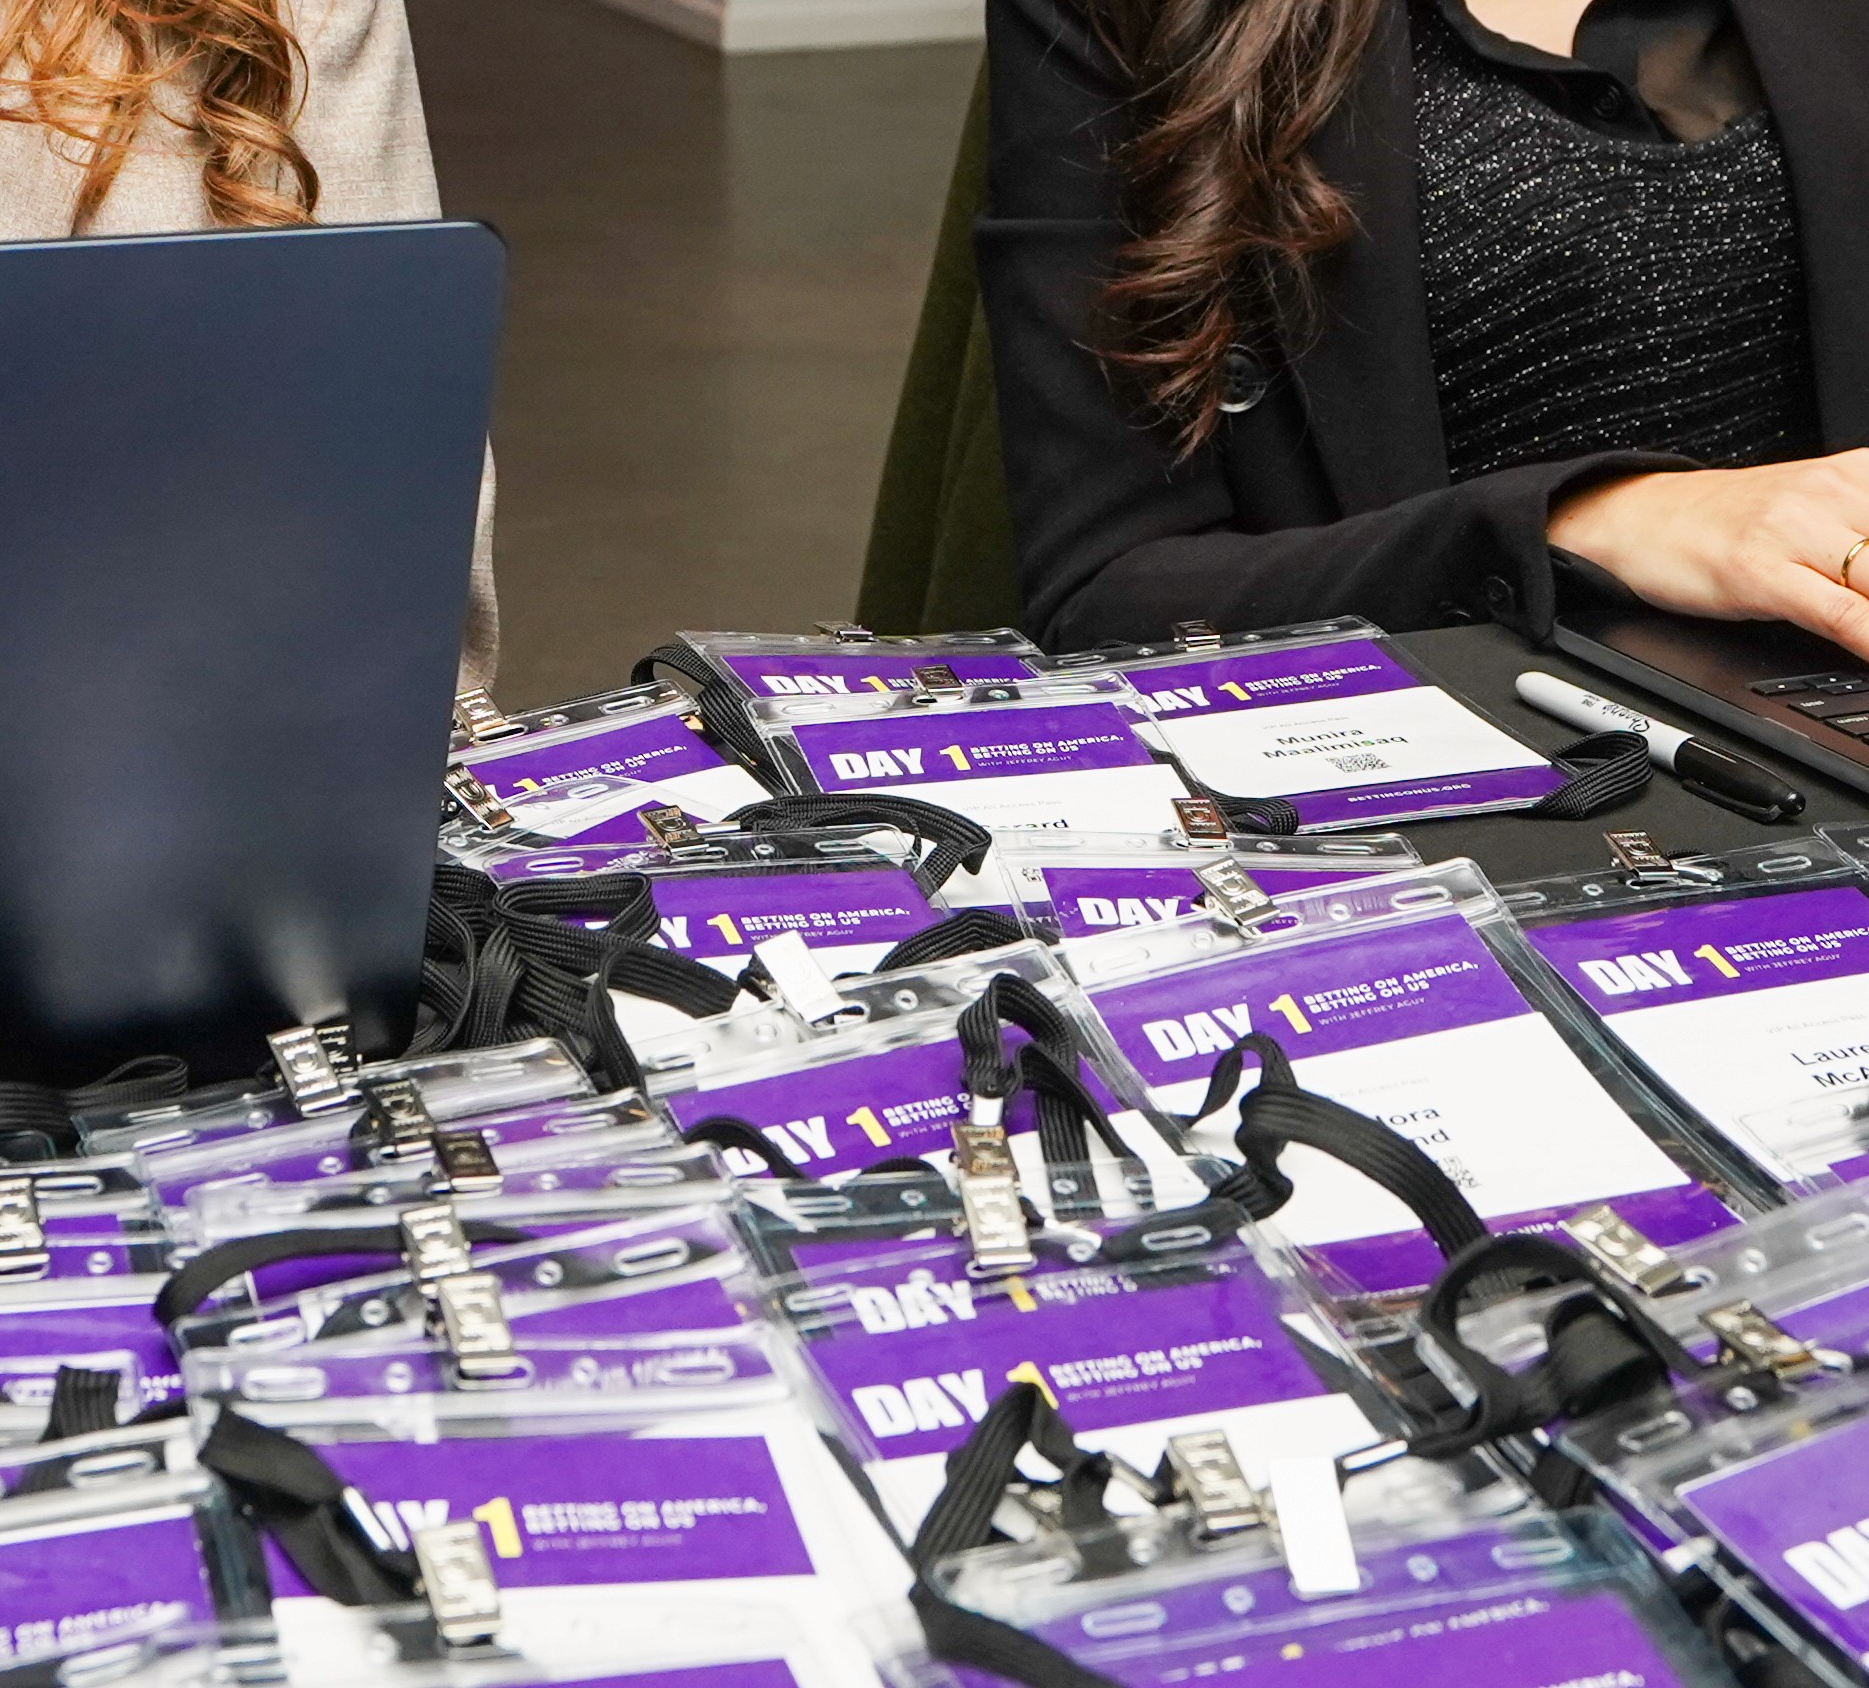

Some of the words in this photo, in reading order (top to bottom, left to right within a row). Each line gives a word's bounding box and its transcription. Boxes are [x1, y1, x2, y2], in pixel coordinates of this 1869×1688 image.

[760, 676, 851, 695] DAY
[1218, 681, 1251, 701] 1
[970, 744, 1028, 755] BETTING
[1032, 740, 1054, 749] ON
[1057, 735, 1124, 748] AMERICA,
[1276, 728, 1364, 746] Munira
[829, 747, 926, 780] DAY
[939, 744, 971, 771] 1
[973, 749, 1032, 760] BETTING
[1036, 746, 1057, 755] ON
[1059, 743, 1080, 752] US
[1347, 783, 1472, 802] BETTINGONUS.ORG
[741, 914, 805, 925] BETTING
[809, 911, 832, 920] ON
[837, 907, 910, 918] AMERICA,
[1077, 897, 1180, 926] DAY
[707, 914, 743, 945] 1
[745, 921, 810, 932] BETTING
[813, 918, 836, 927] ON
[839, 916, 861, 925] US
[1724, 938, 1788, 956] BETTING
[1791, 933, 1813, 946] ON
[1731, 946, 1795, 963] BETTING
[1798, 942, 1819, 954] ON
[1819, 939, 1842, 950] US
[1578, 950, 1693, 996] DAY
[1693, 944, 1740, 979] 1
[1303, 983, 1371, 1006] BETTING
[1374, 977, 1400, 990] ON
[1403, 960, 1479, 984] AMERICA,
[1309, 993, 1377, 1015] BETTING
[1380, 987, 1405, 1000] ON
[1406, 980, 1430, 993] US
[1142, 1003, 1253, 1063] DAY
[1269, 994, 1312, 1034] 1
[882, 1095, 953, 1118] BETTING
[887, 1104, 959, 1127] BETTING
[846, 1106, 891, 1147] 1
[850, 1279, 976, 1334] DAY
[852, 1369, 989, 1438] DAY
[473, 1496, 523, 1558] 1
